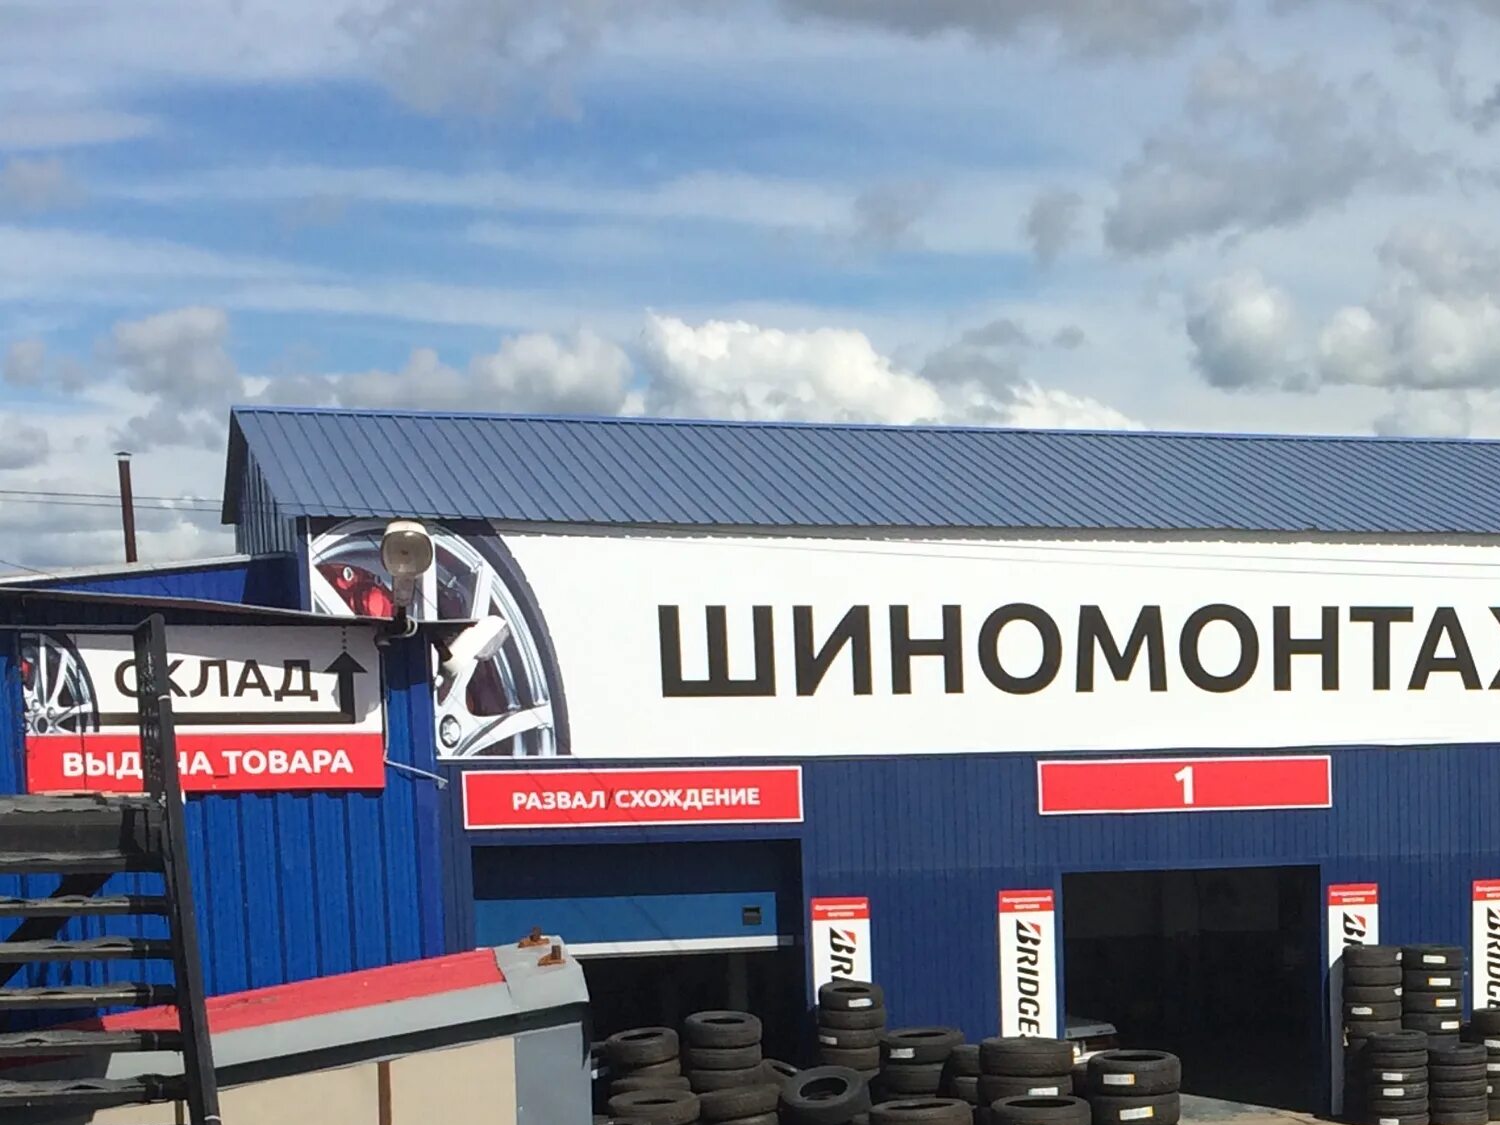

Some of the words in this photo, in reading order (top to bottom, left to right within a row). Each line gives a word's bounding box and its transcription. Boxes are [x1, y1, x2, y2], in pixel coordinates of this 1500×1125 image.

[62, 751, 214, 780] ВЫДА
[221, 749, 354, 775] ТОВАРА
[1174, 766, 1194, 805] 1
[1016, 919, 1041, 1038] BRIDGE
